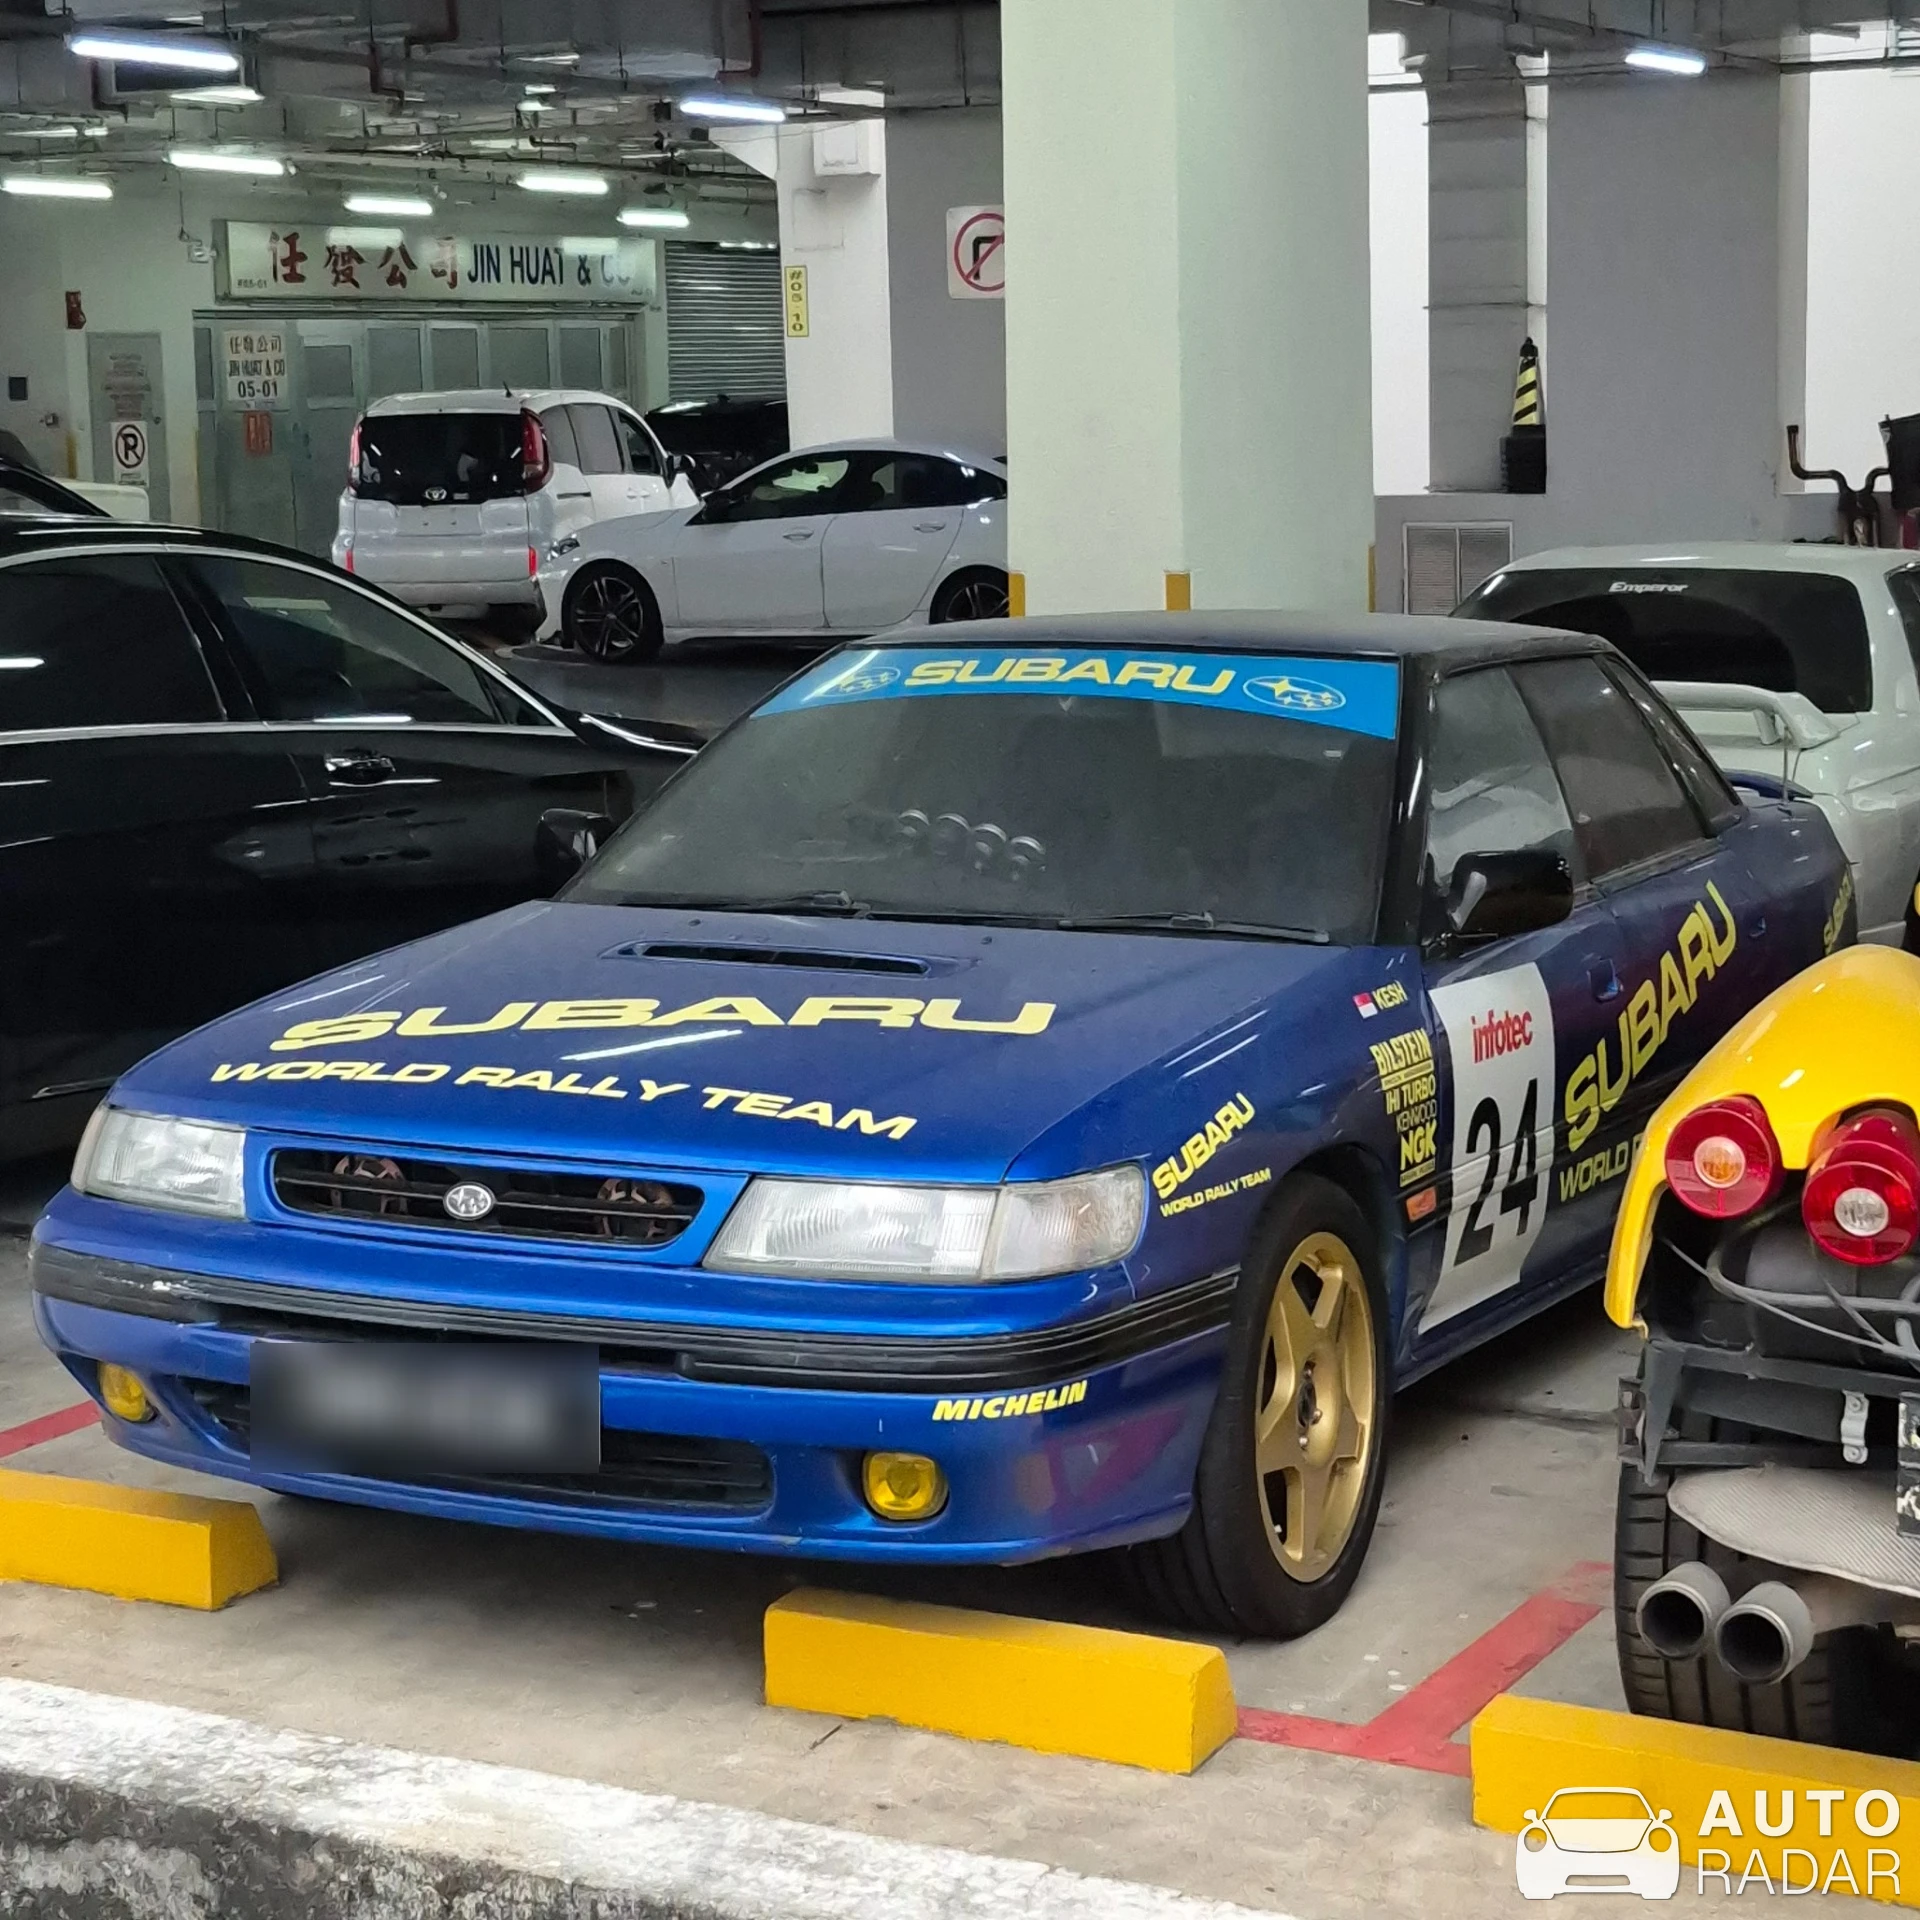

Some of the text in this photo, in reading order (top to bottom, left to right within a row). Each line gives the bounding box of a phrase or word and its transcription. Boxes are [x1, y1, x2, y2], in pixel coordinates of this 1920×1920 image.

[467, 243, 501, 284] JIN
[510, 246, 565, 285] HUAT
[577, 254, 592, 287] &
[237, 380, 279, 398] 05-01
[1608, 581, 1689, 594] Emperor
[905, 659, 1235, 694] SUBARU
[1373, 980, 1408, 1010] KESH
[1564, 880, 1737, 1152] SUBARU
[270, 996, 1057, 1052] SUBARU
[1471, 1010, 1533, 1064] infotec
[1369, 1028, 1433, 1076] BILSTEIN
[210, 1061, 919, 1141] WORLD RALLY TEAM
[1400, 1073, 1436, 1108] TURBO
[1152, 1091, 1256, 1200] SUBARU
[1400, 1119, 1438, 1171] NGK
[1160, 1166, 1272, 1217] WORLD RALLY TEAM
[1453, 1078, 1538, 1267] 24
[1559, 1140, 1630, 1203] WORLD
[932, 1380, 1088, 1421] MICHELIN
